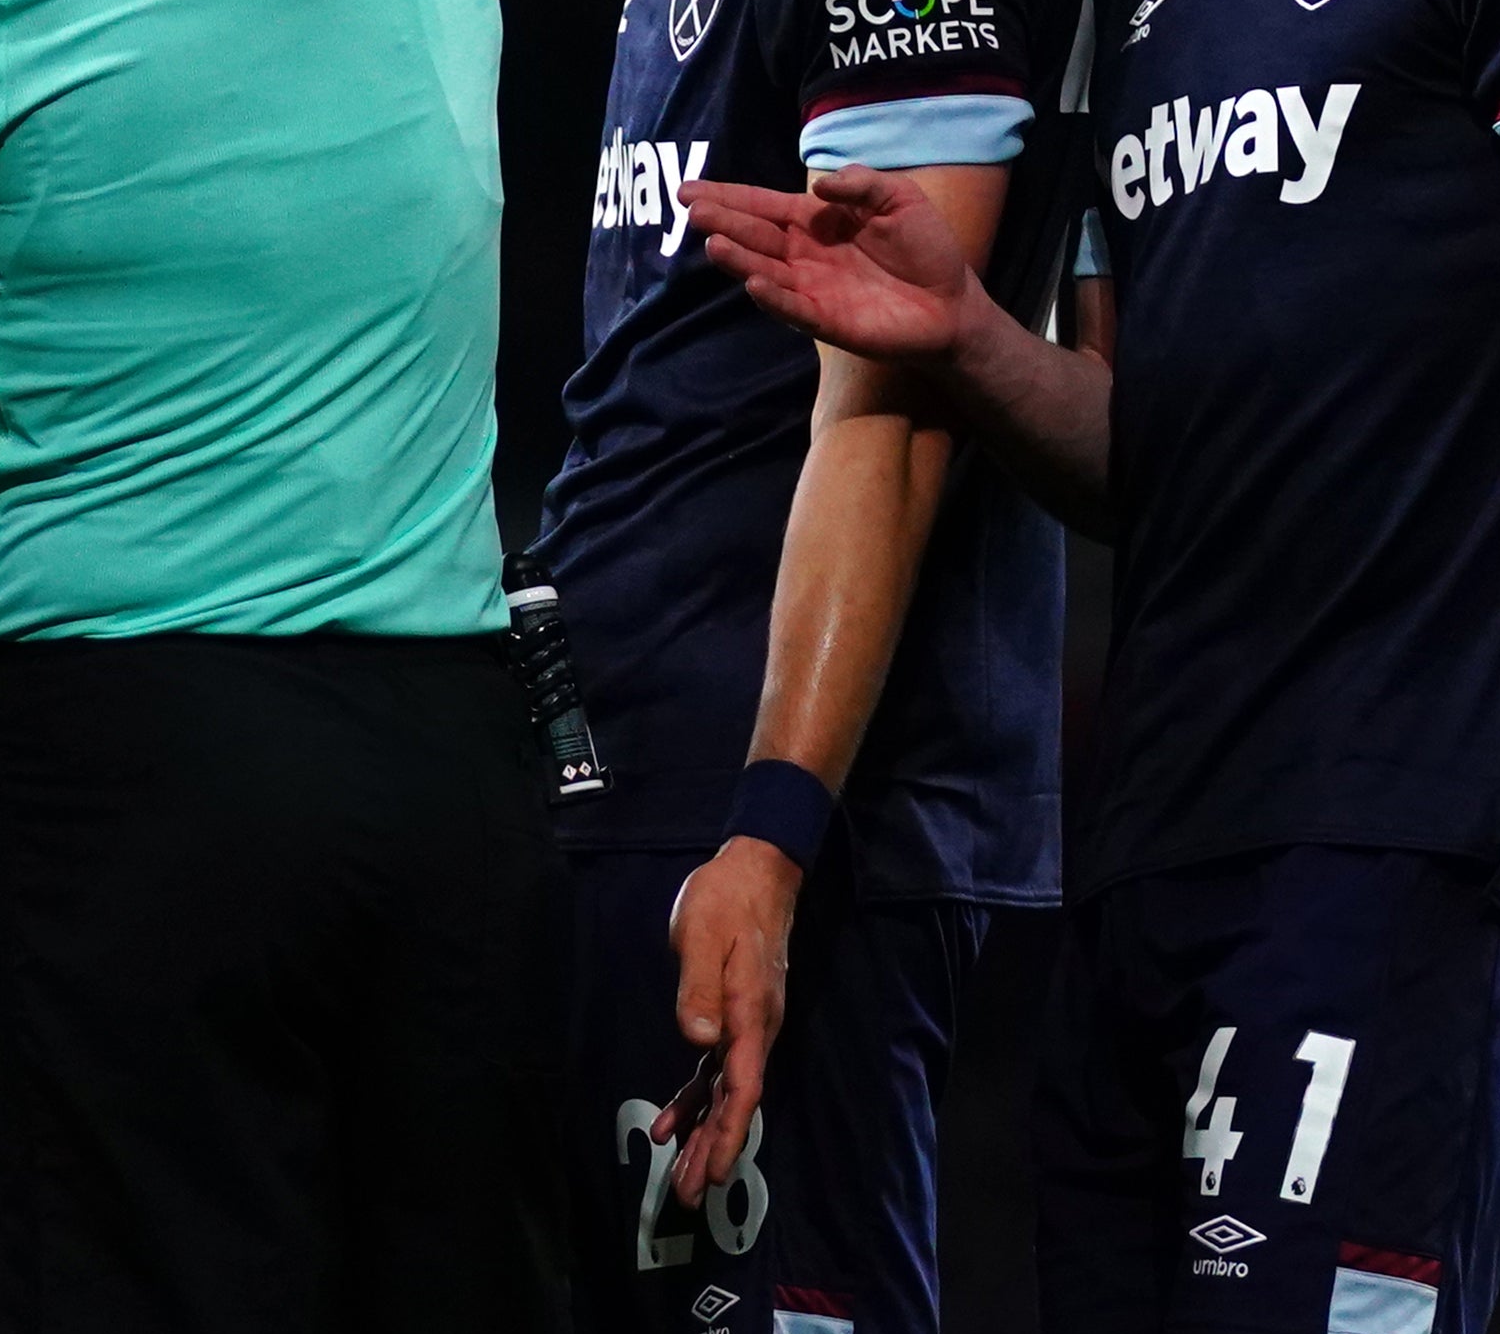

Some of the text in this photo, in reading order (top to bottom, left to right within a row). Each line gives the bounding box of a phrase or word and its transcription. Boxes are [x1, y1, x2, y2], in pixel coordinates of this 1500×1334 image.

[829, 20, 1000, 69] MARKETS
[592, 127, 711, 258] etway
[1111, 83, 1362, 221] etway
[1183, 1027, 1357, 1205] 41
[615, 1098, 770, 1271] 28
[1192, 1256, 1249, 1278] umbro
